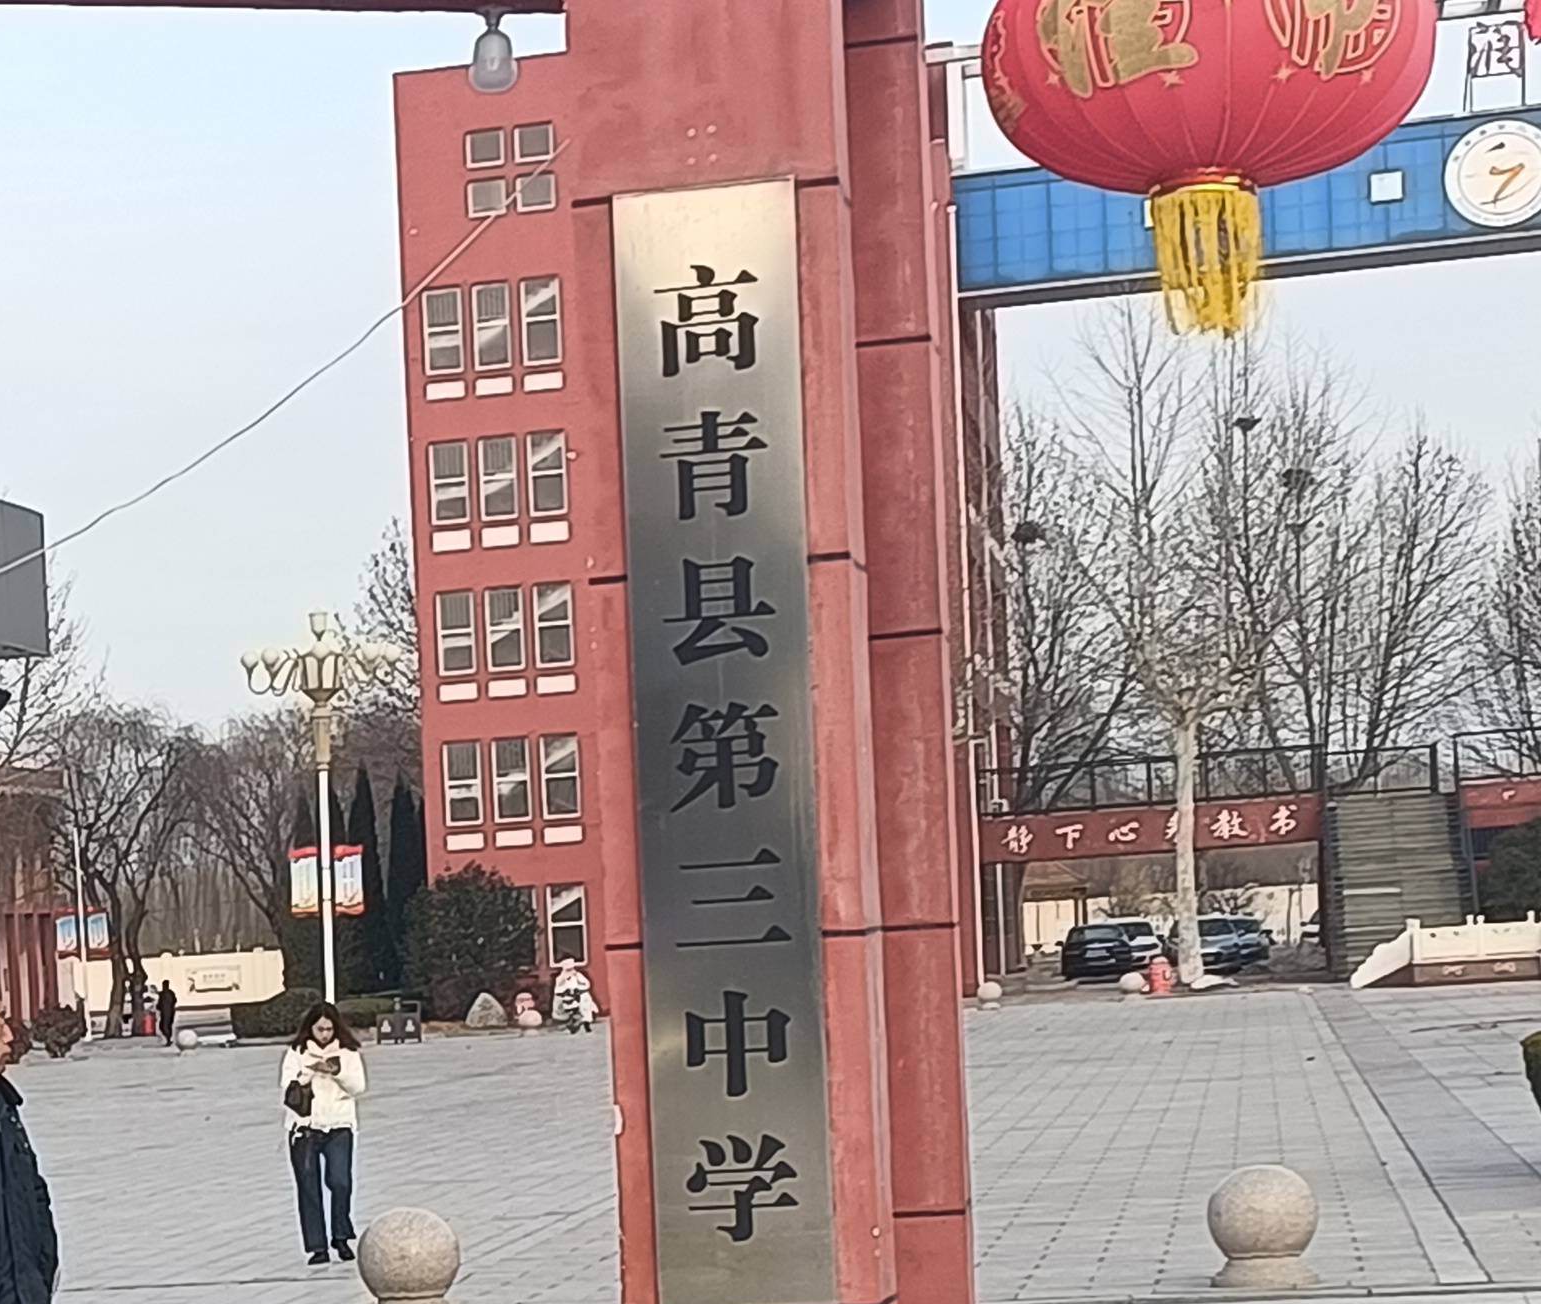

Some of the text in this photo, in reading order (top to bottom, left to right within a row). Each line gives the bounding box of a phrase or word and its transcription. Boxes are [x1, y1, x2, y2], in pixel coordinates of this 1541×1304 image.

[654, 265, 799, 1242] 高青县第三中学
